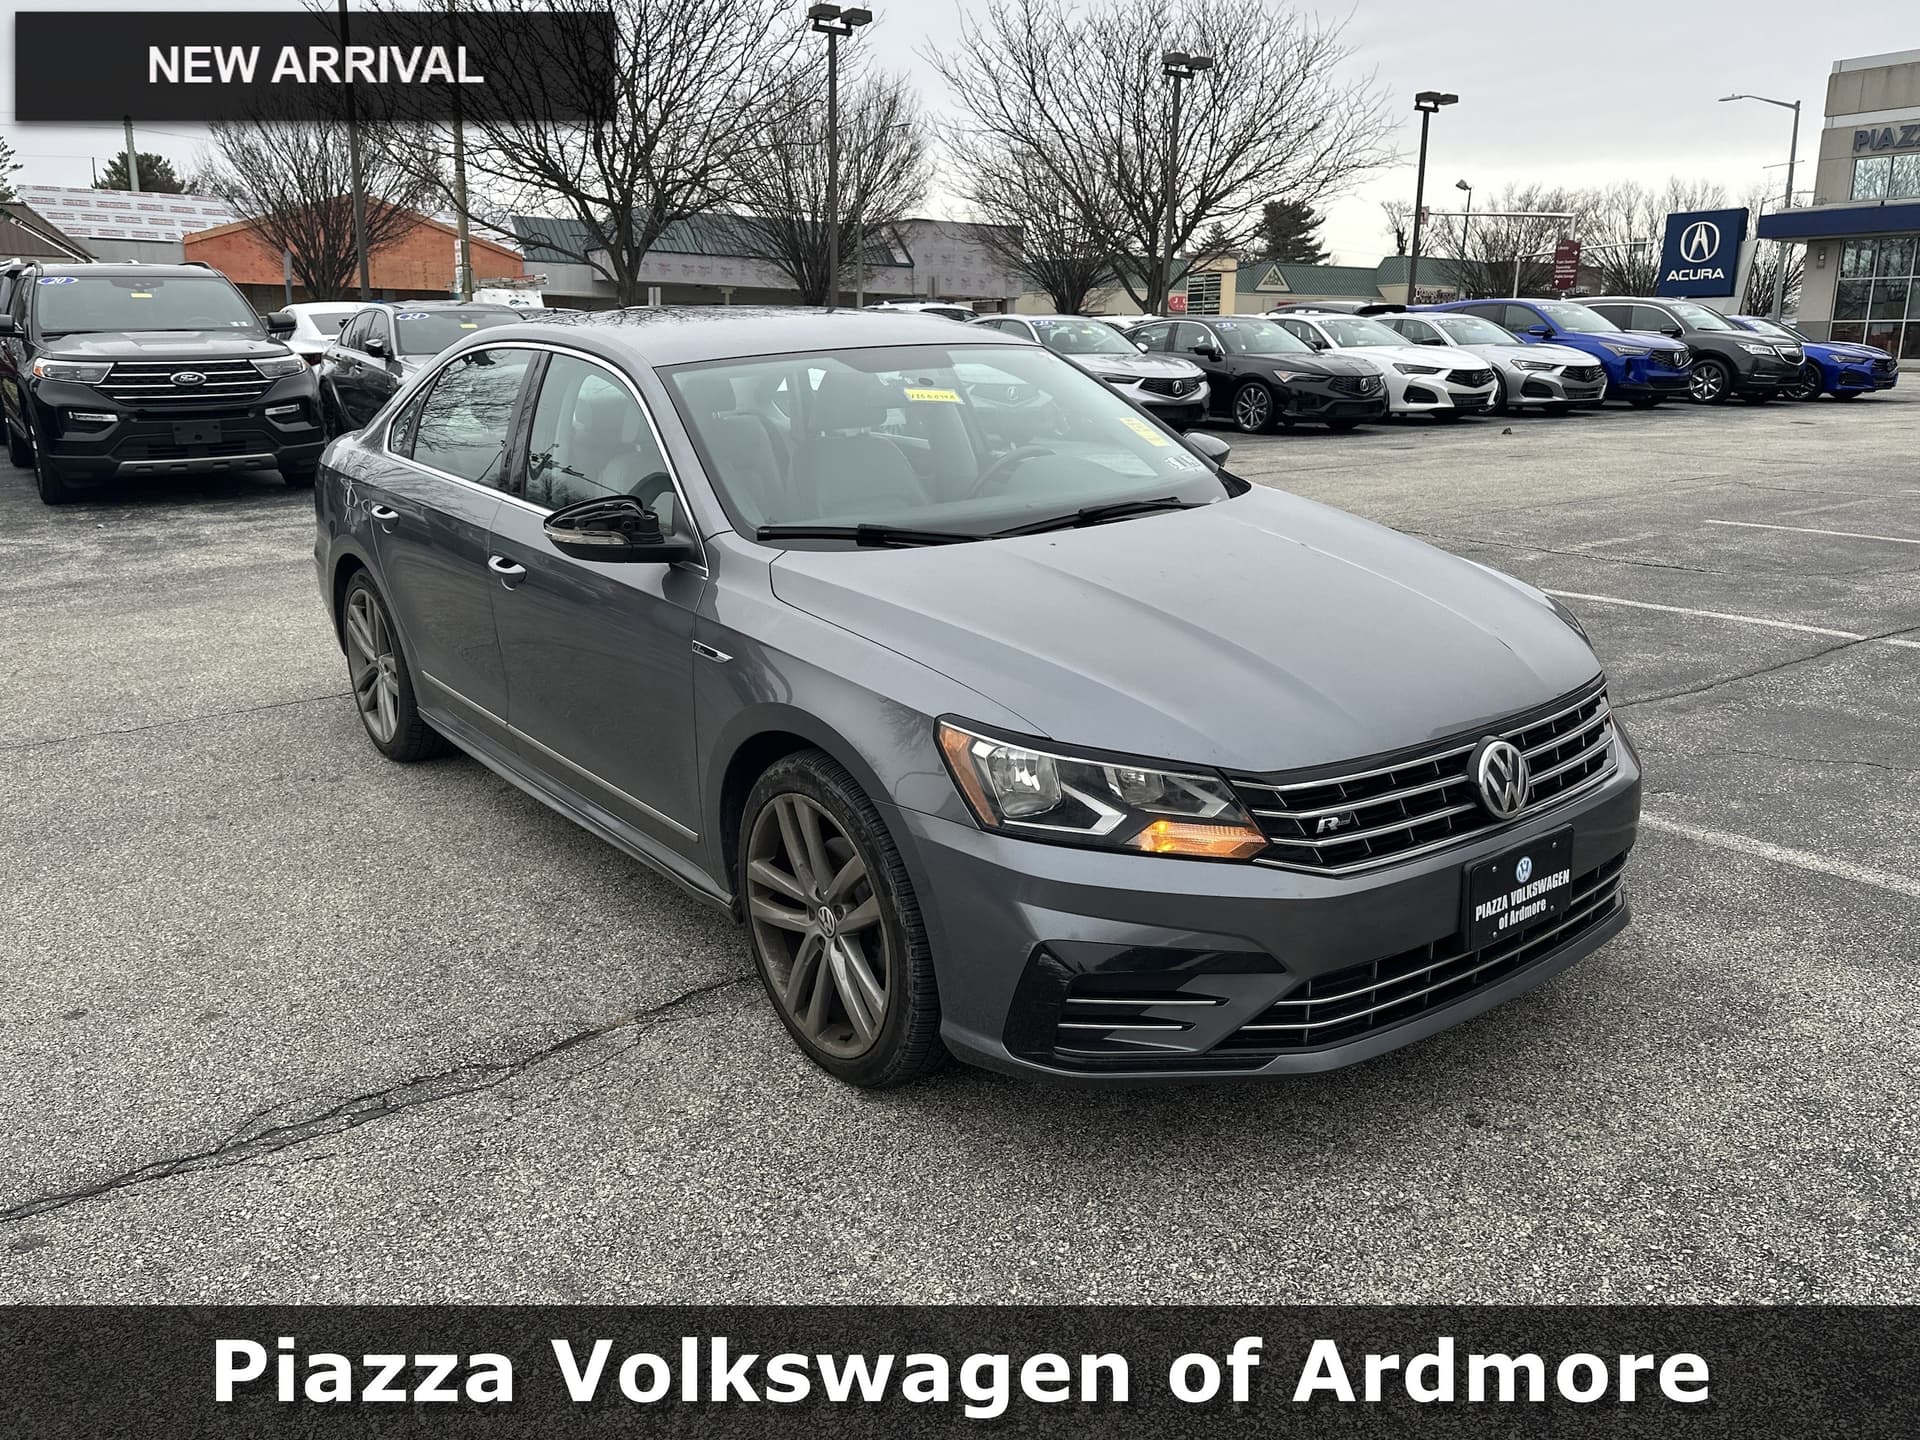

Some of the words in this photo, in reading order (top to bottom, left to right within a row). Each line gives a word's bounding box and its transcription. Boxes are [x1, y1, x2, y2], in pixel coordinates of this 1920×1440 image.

[1853, 124, 1920, 152] PIAZ
[1666, 268, 1724, 281] ACURA
[1475, 894, 1508, 922] PIAZZA
[1510, 868, 1570, 907] VOLKSWAGEN
[1498, 912, 1509, 930] of
[1509, 898, 1547, 926] Ardmore
